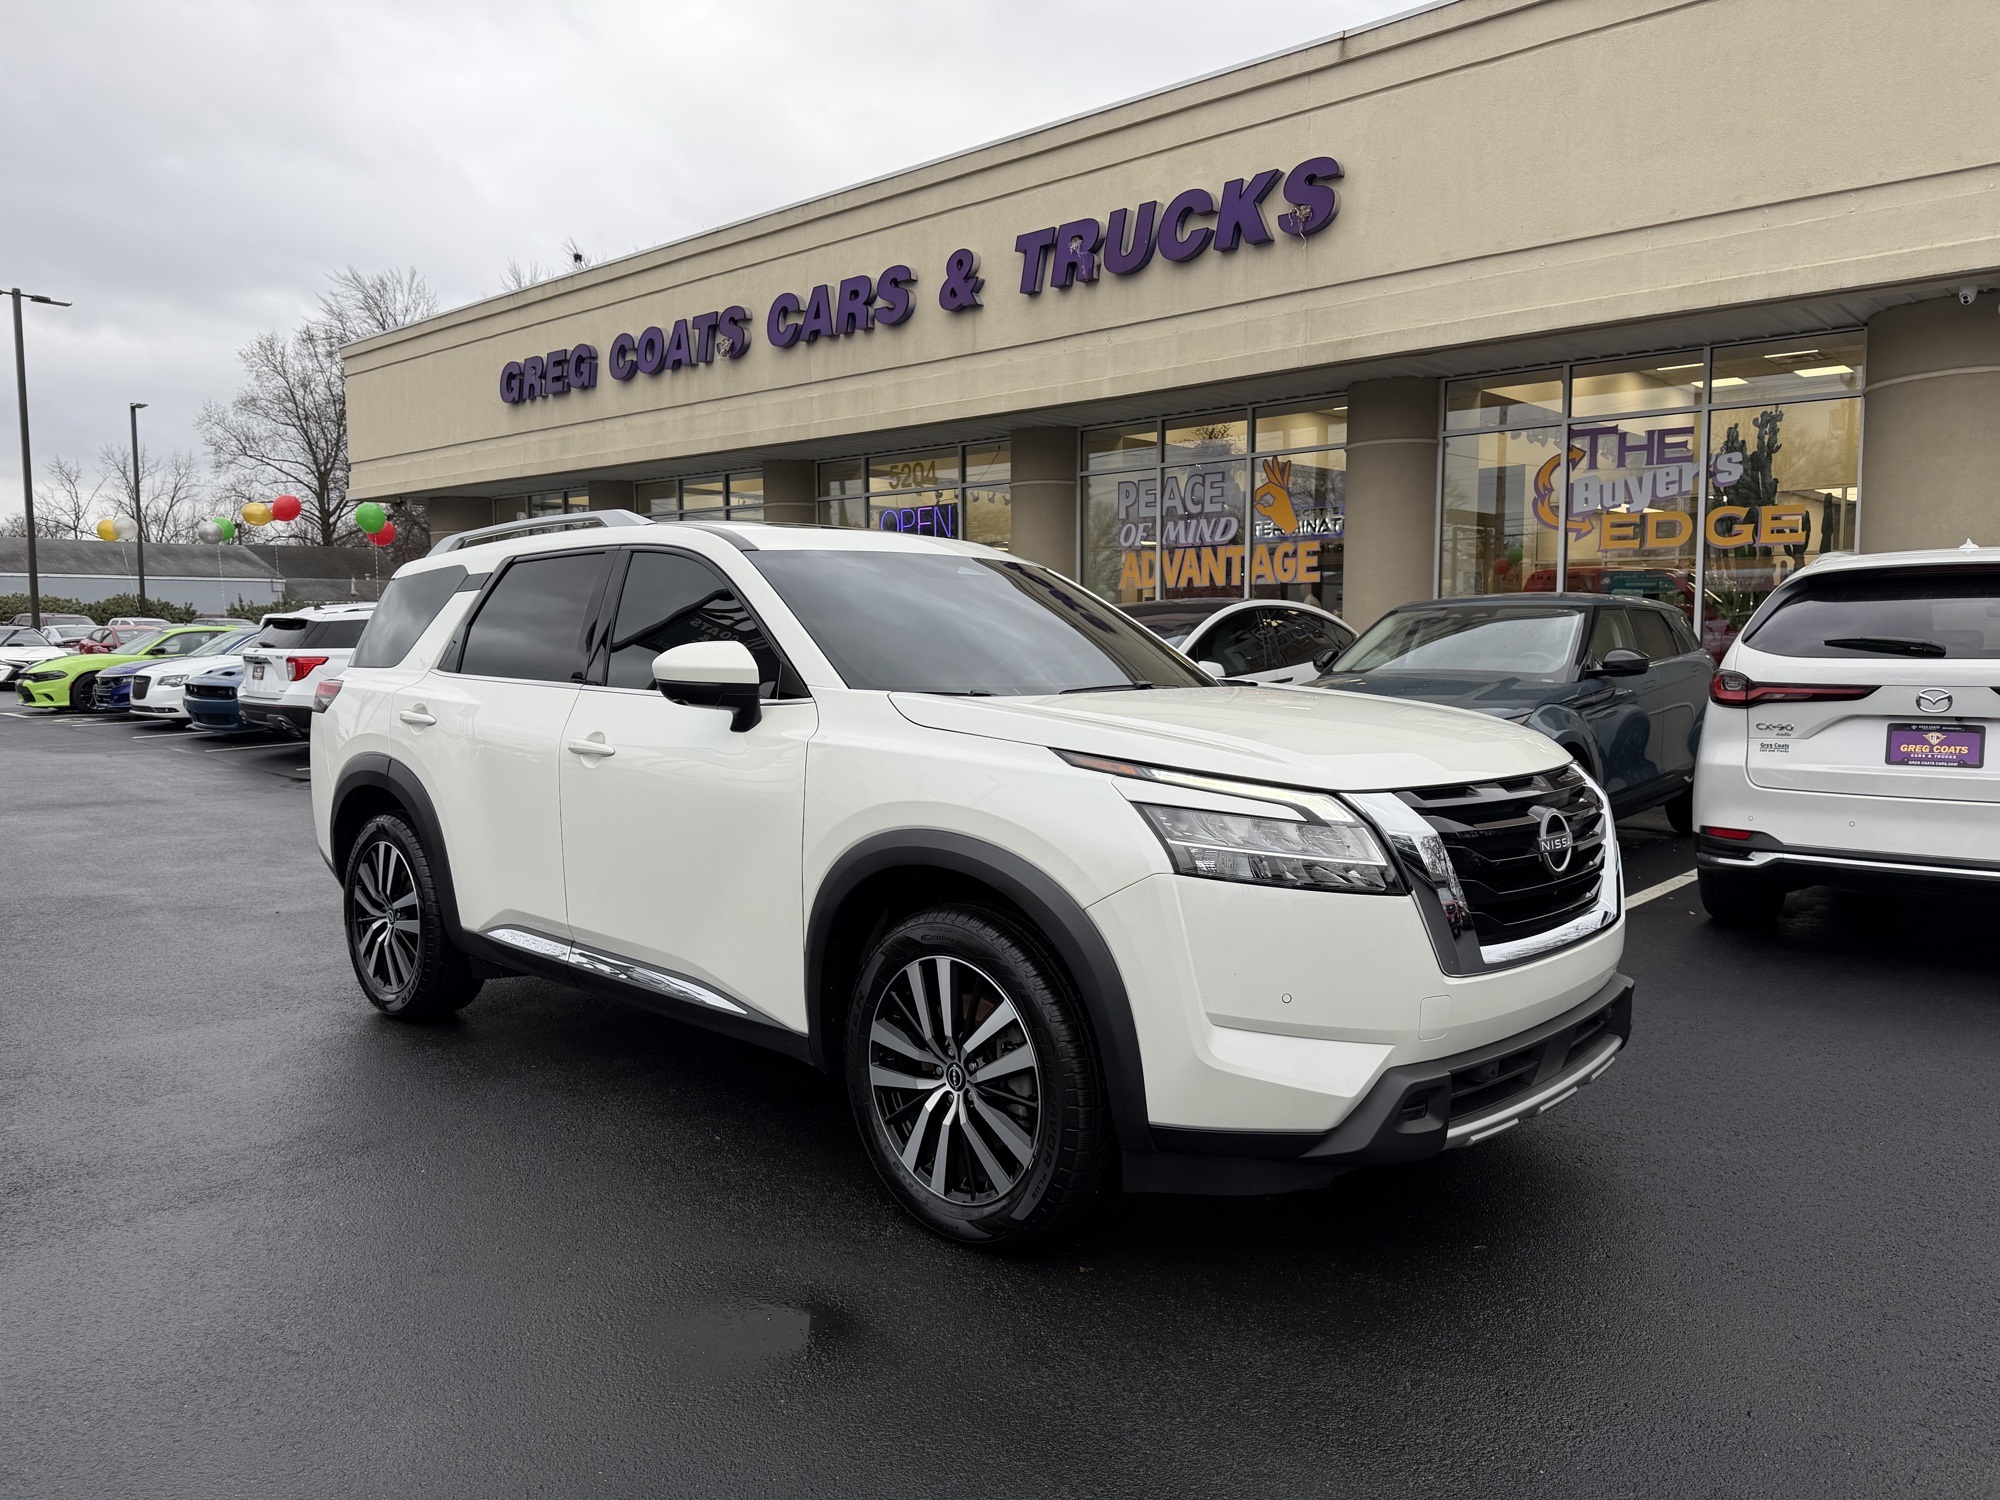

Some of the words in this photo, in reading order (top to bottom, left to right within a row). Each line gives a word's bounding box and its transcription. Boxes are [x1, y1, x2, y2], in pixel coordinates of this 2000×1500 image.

[500, 343, 598, 404] GREG
[609, 305, 752, 382] COATS
[767, 264, 918, 348] CARS
[939, 248, 985, 312] &
[1015, 156, 1345, 296] TRUCKS
[1570, 425, 1695, 472] THE
[888, 460, 938, 490] 5204
[1571, 450, 1744, 517] Buyer's
[1118, 471, 1226, 519] PEACE
[880, 505, 952, 538] OPEN
[1119, 522, 1156, 549] OF
[1162, 516, 1239, 547] MIND
[1254, 517, 1345, 538] TERINAT
[1598, 503, 1808, 552] EDGE
[1118, 540, 1321, 591] ADVANTAGE
[1755, 722, 1794, 732] CX-90
[1900, 744, 1930, 753] GREG
[1933, 745, 1969, 754] COATS
[1541, 837, 1571, 851] NISSA
[1031, 1171, 1047, 1200] PLUS
